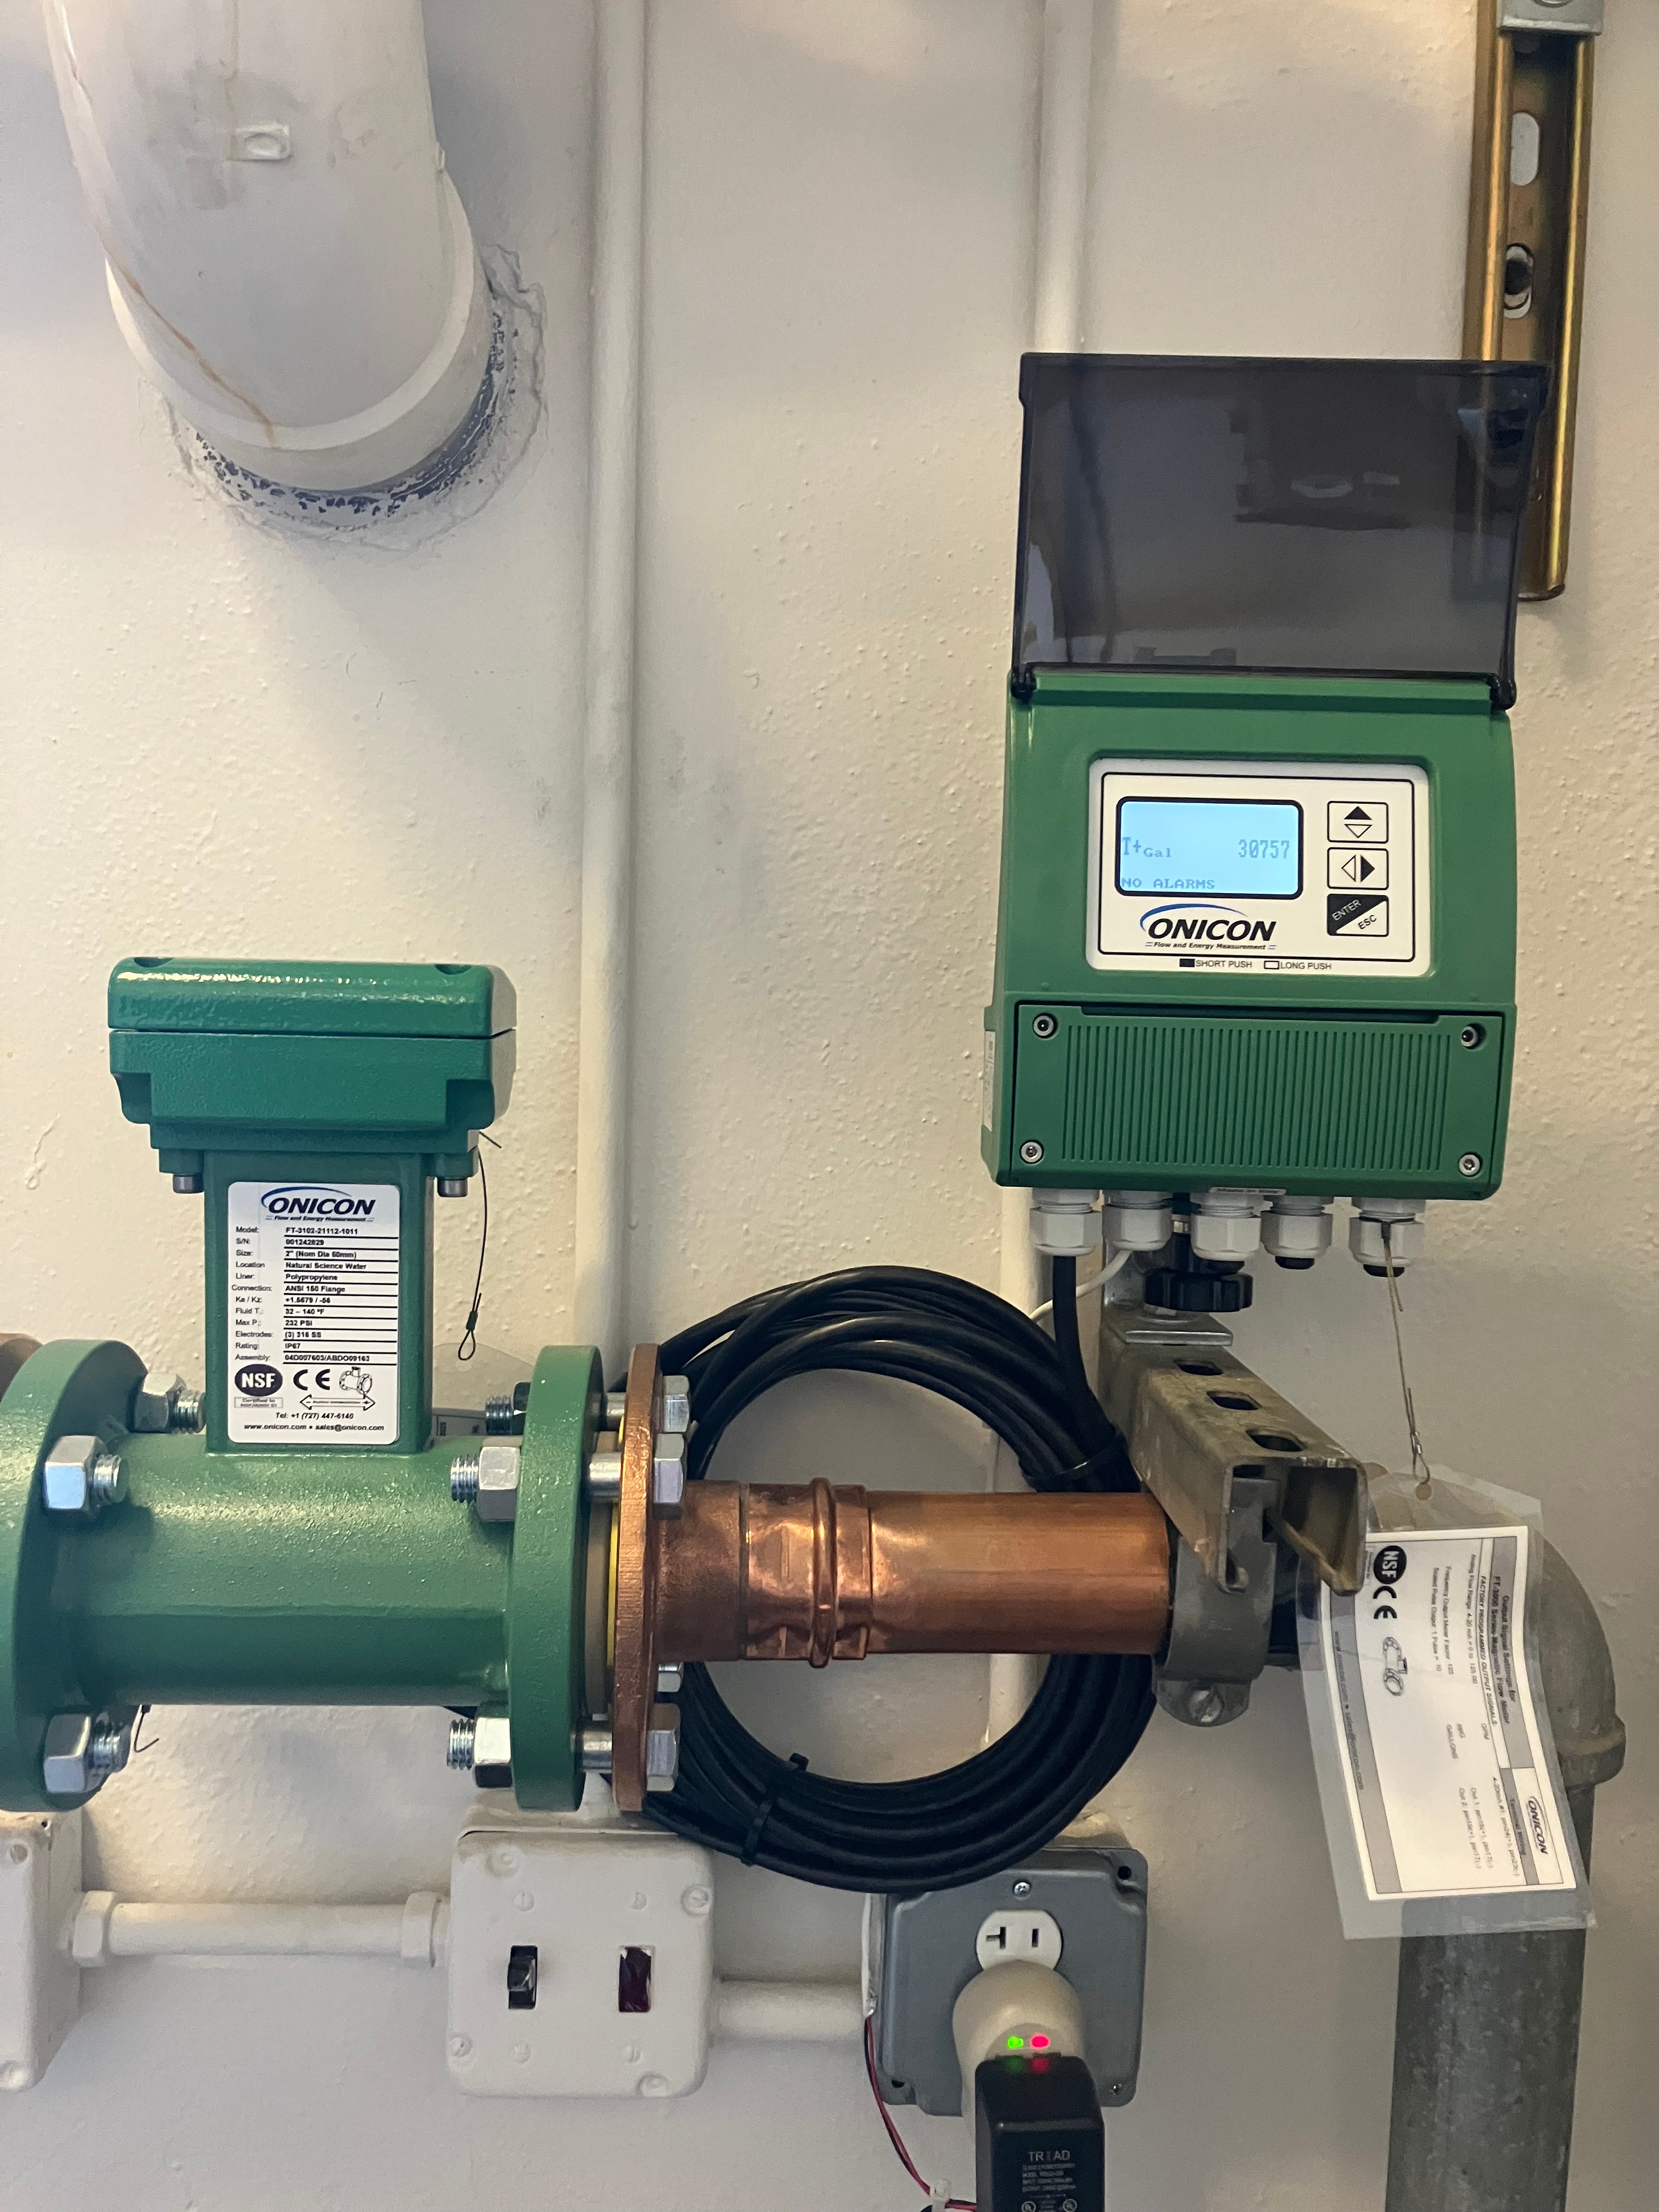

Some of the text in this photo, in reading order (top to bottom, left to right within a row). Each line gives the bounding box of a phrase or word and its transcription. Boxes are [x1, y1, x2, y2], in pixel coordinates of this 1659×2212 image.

[1238, 839, 1290, 859] 30757
[1121, 878, 1216, 889] NO ALARMS
[1331, 899, 1362, 921] ENTER
[1148, 918, 1277, 941] ONICON
[1358, 915, 1376, 930] ESC
[1195, 960, 1226, 968] SHORT
[268, 1197, 376, 1215] ONICON
[285, 1273, 338, 1282] Polypropylene
[320, 1286, 346, 1294] Flange
[242, 1373, 275, 1388] NSF
[1381, 1551, 1399, 1579] NSF
[1481, 1662, 1491, 1691] OUTPUT
[1528, 1800, 1548, 1855] ONICON
[1028, 2150, 1070, 2162] TRIAD
